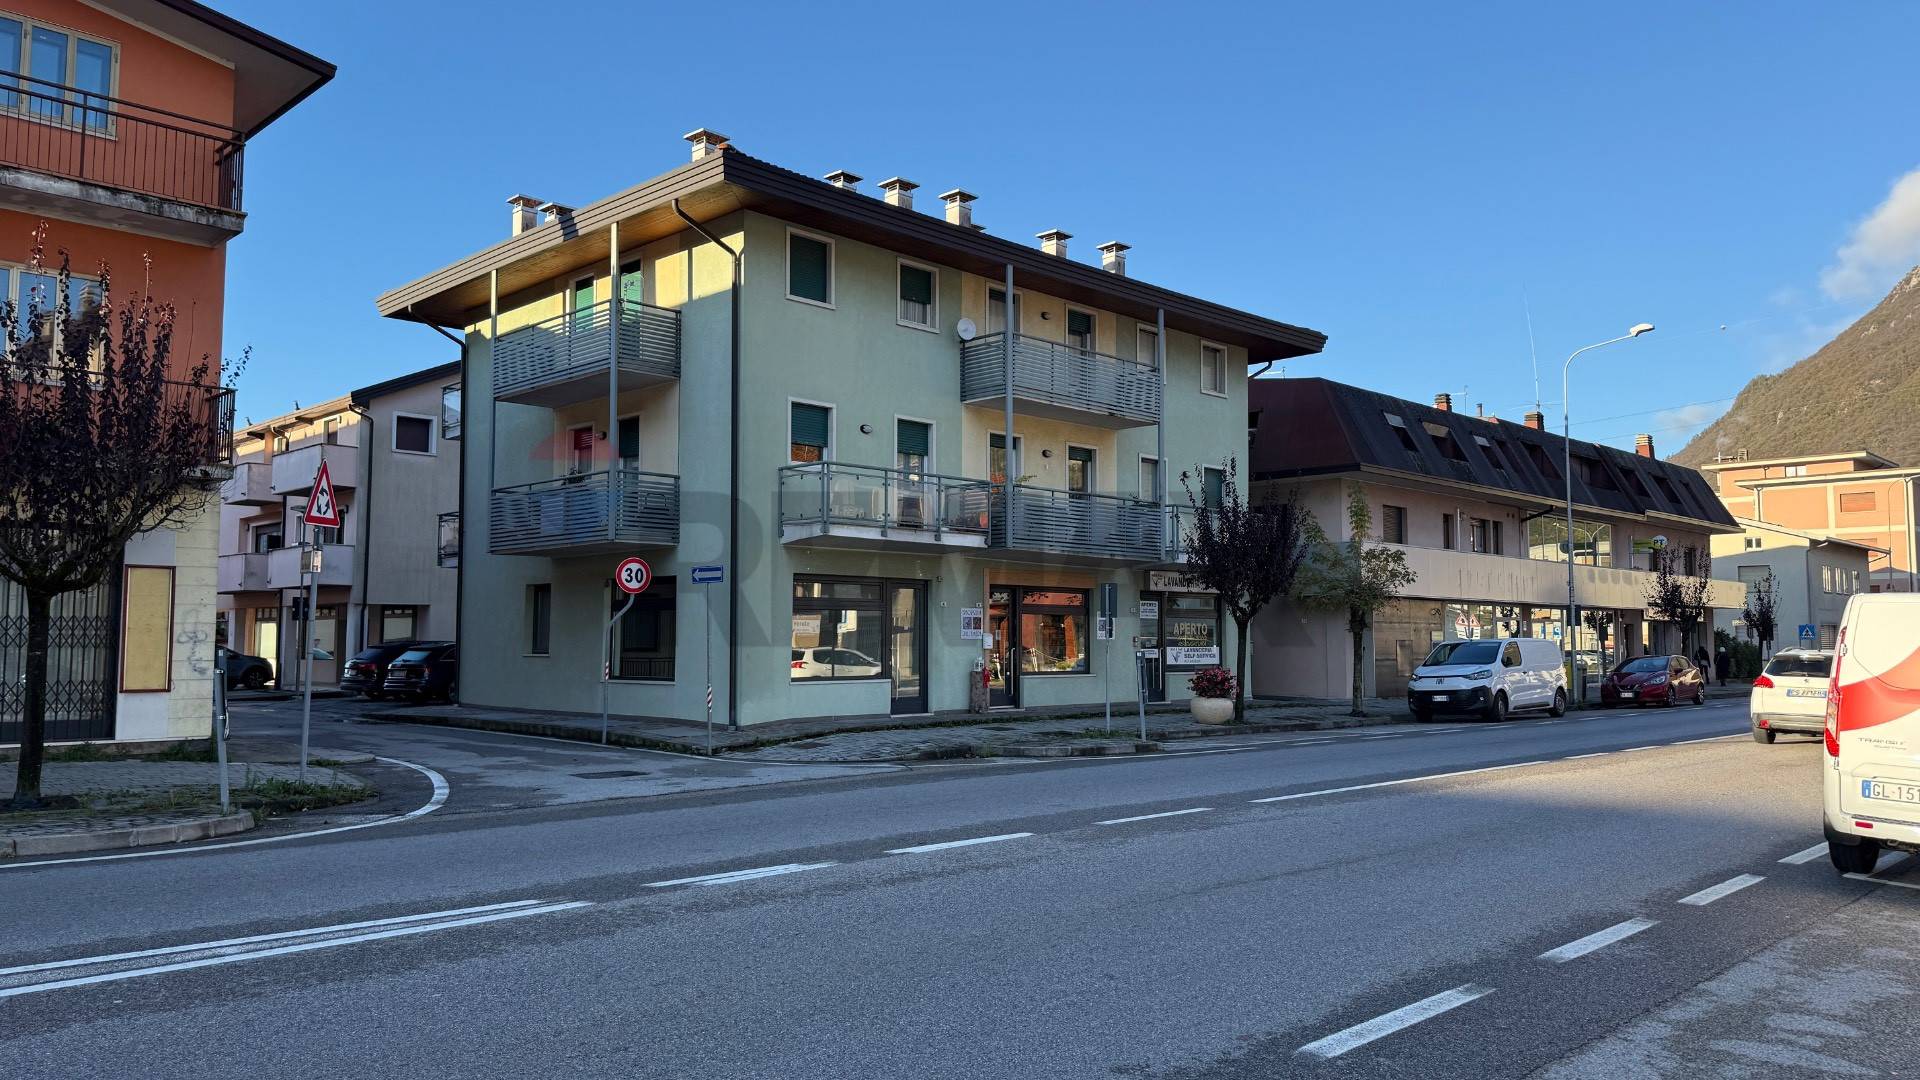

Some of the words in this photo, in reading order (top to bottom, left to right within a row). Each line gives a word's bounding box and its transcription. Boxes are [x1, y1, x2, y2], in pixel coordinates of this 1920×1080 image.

[624, 567, 644, 584] 30
[1163, 576, 1200, 589] LAVAND
[1173, 622, 1208, 635] APERTO
